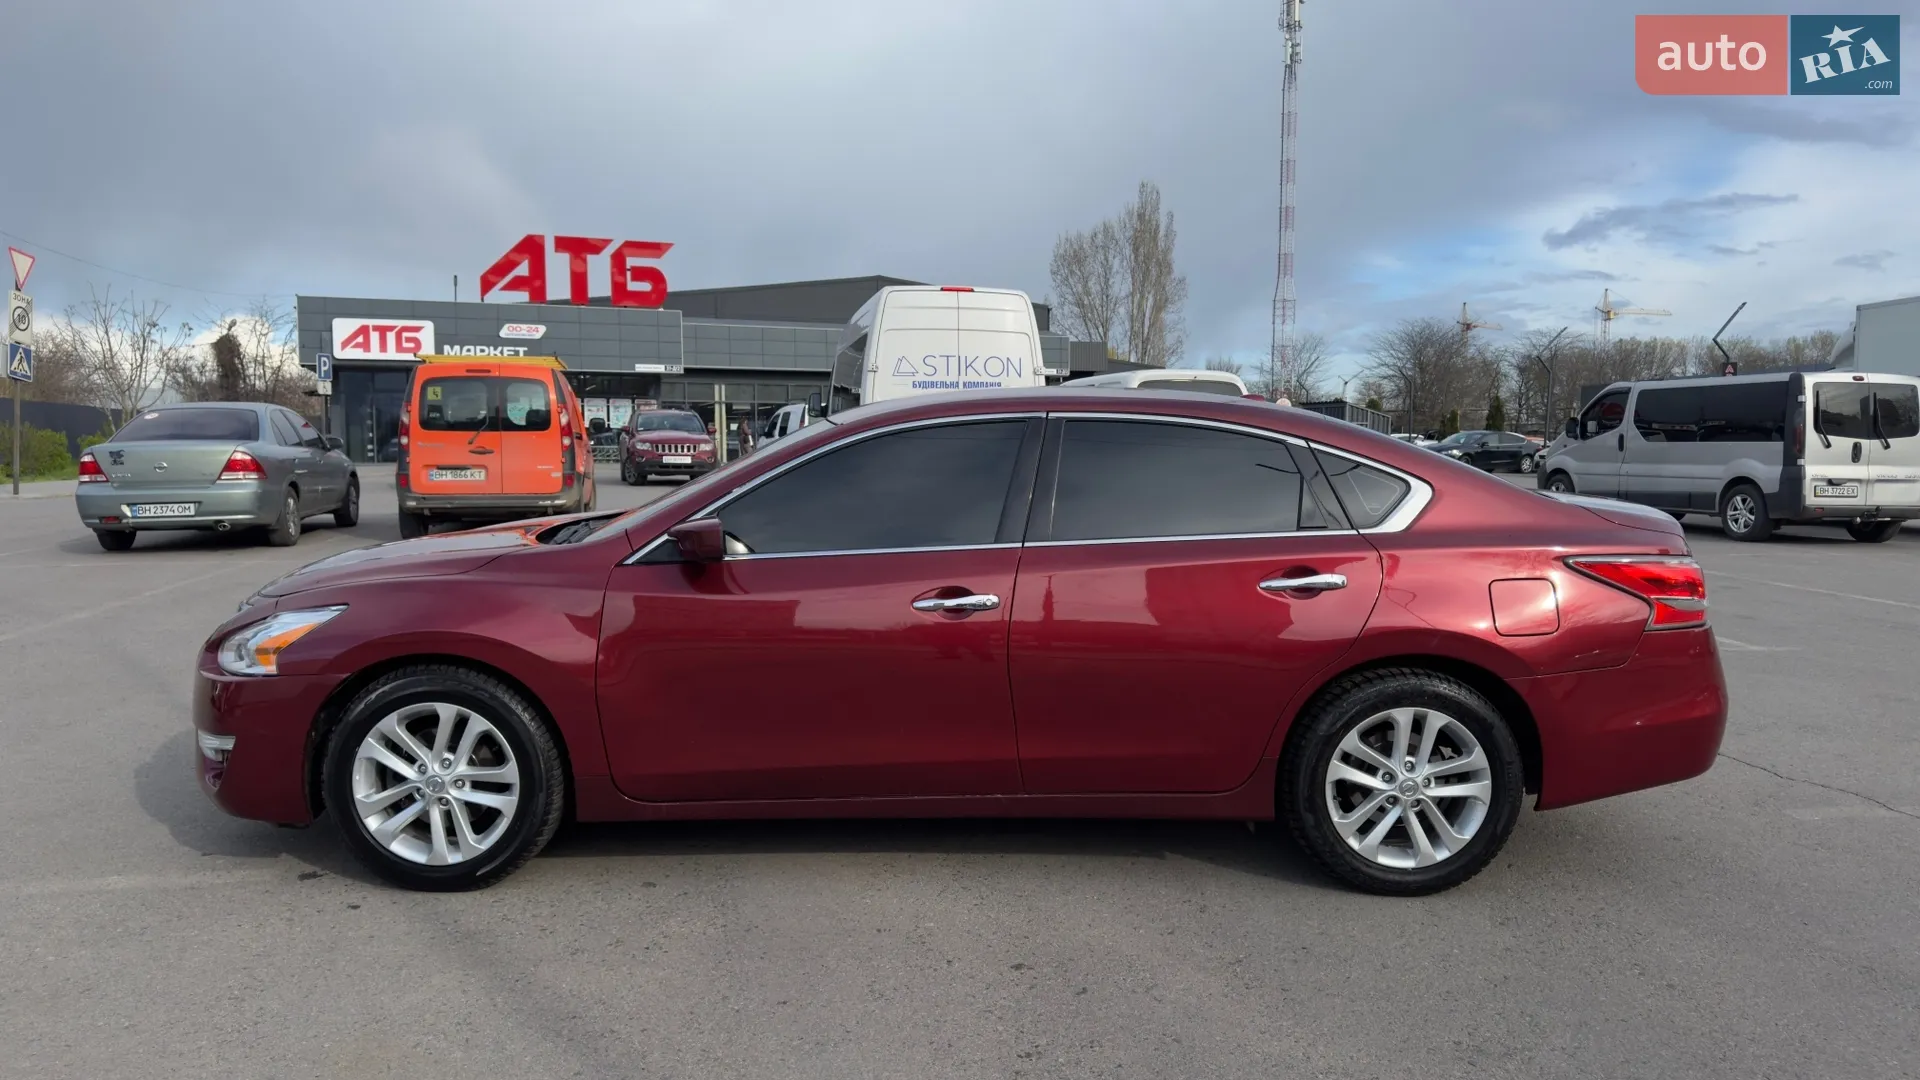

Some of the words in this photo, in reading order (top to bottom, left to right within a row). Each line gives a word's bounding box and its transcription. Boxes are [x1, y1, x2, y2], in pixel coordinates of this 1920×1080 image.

[480, 234, 674, 309] АТБ
[340, 324, 425, 354] АТБ
[443, 344, 528, 357] МАРКЕТ
[922, 354, 1022, 378] STIKON
[912, 380, 959, 390] БУДІВЕЛЬНА
[434, 471, 448, 479] BH
[449, 471, 469, 479] 1866
[1819, 487, 1829, 495] BH
[1830, 487, 1845, 495] 3722
[137, 505, 151, 515] BH
[153, 505, 175, 515] 2374
[177, 504, 191, 514] OM
